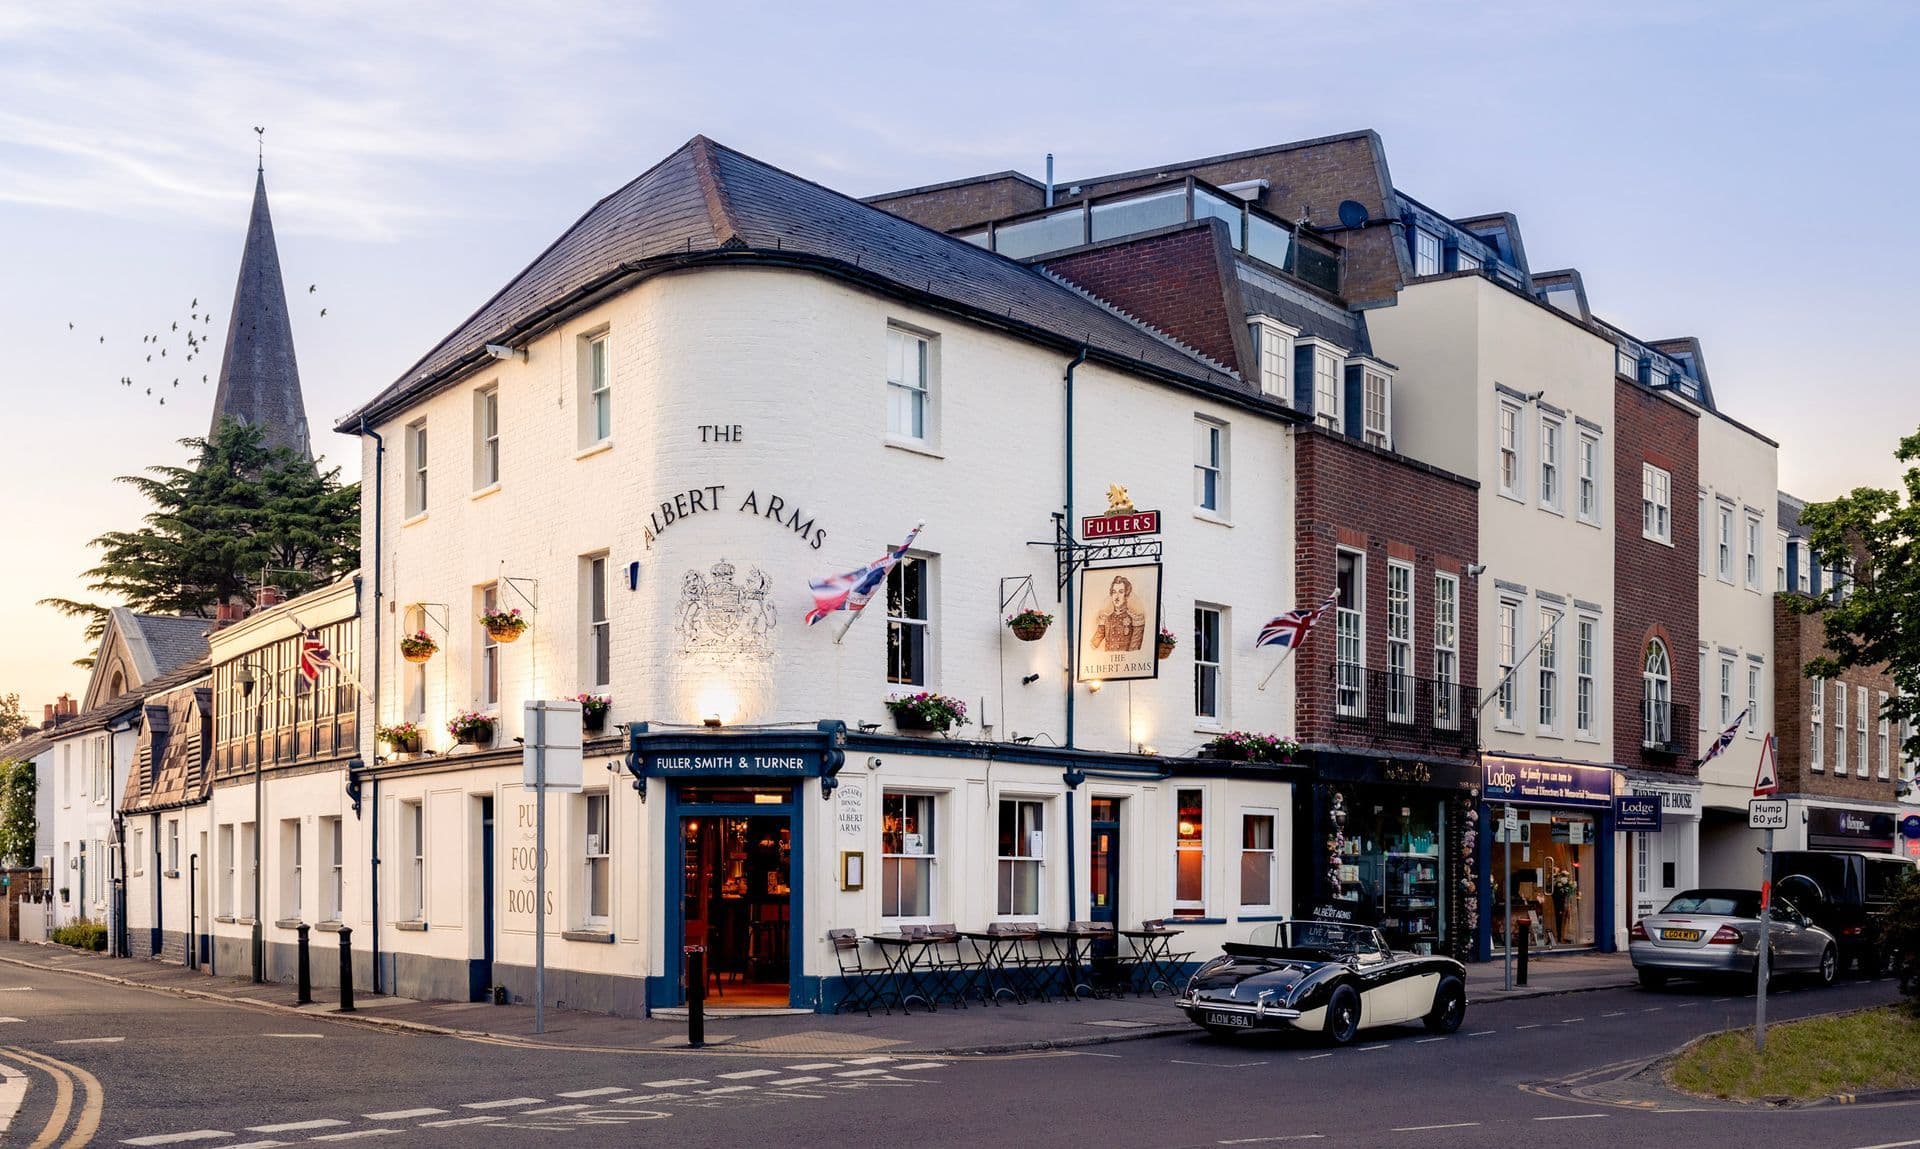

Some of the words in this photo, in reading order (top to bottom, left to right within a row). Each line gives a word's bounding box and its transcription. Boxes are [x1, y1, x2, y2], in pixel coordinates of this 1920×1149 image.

[698, 425, 743, 442] THE
[643, 485, 725, 551] ALBERT
[739, 490, 828, 550] ARMS
[1087, 517, 1151, 534] FULLER'S
[1110, 653, 1126, 663] THE
[1084, 664, 1120, 674] ALBERT
[1123, 661, 1152, 673] ARMS
[657, 758, 693, 770] FULLER,
[694, 757, 733, 769] SMITH
[738, 757, 749, 769] &
[754, 757, 804, 770] TURNER
[1487, 765, 1516, 794] Lodge
[1672, 792, 1692, 809] HOUSE
[1622, 801, 1654, 815] Lodge
[1755, 804, 1782, 814] Hump
[519, 804, 537, 828] PU
[839, 813, 863, 822] ALBERT
[1753, 815, 1765, 823] 60
[1767, 814, 1783, 825] yds
[840, 823, 861, 832] ARMS
[508, 889, 553, 915] ROOS
[1211, 1013, 1229, 1025] AOW
[1230, 1015, 1248, 1026] 36A
